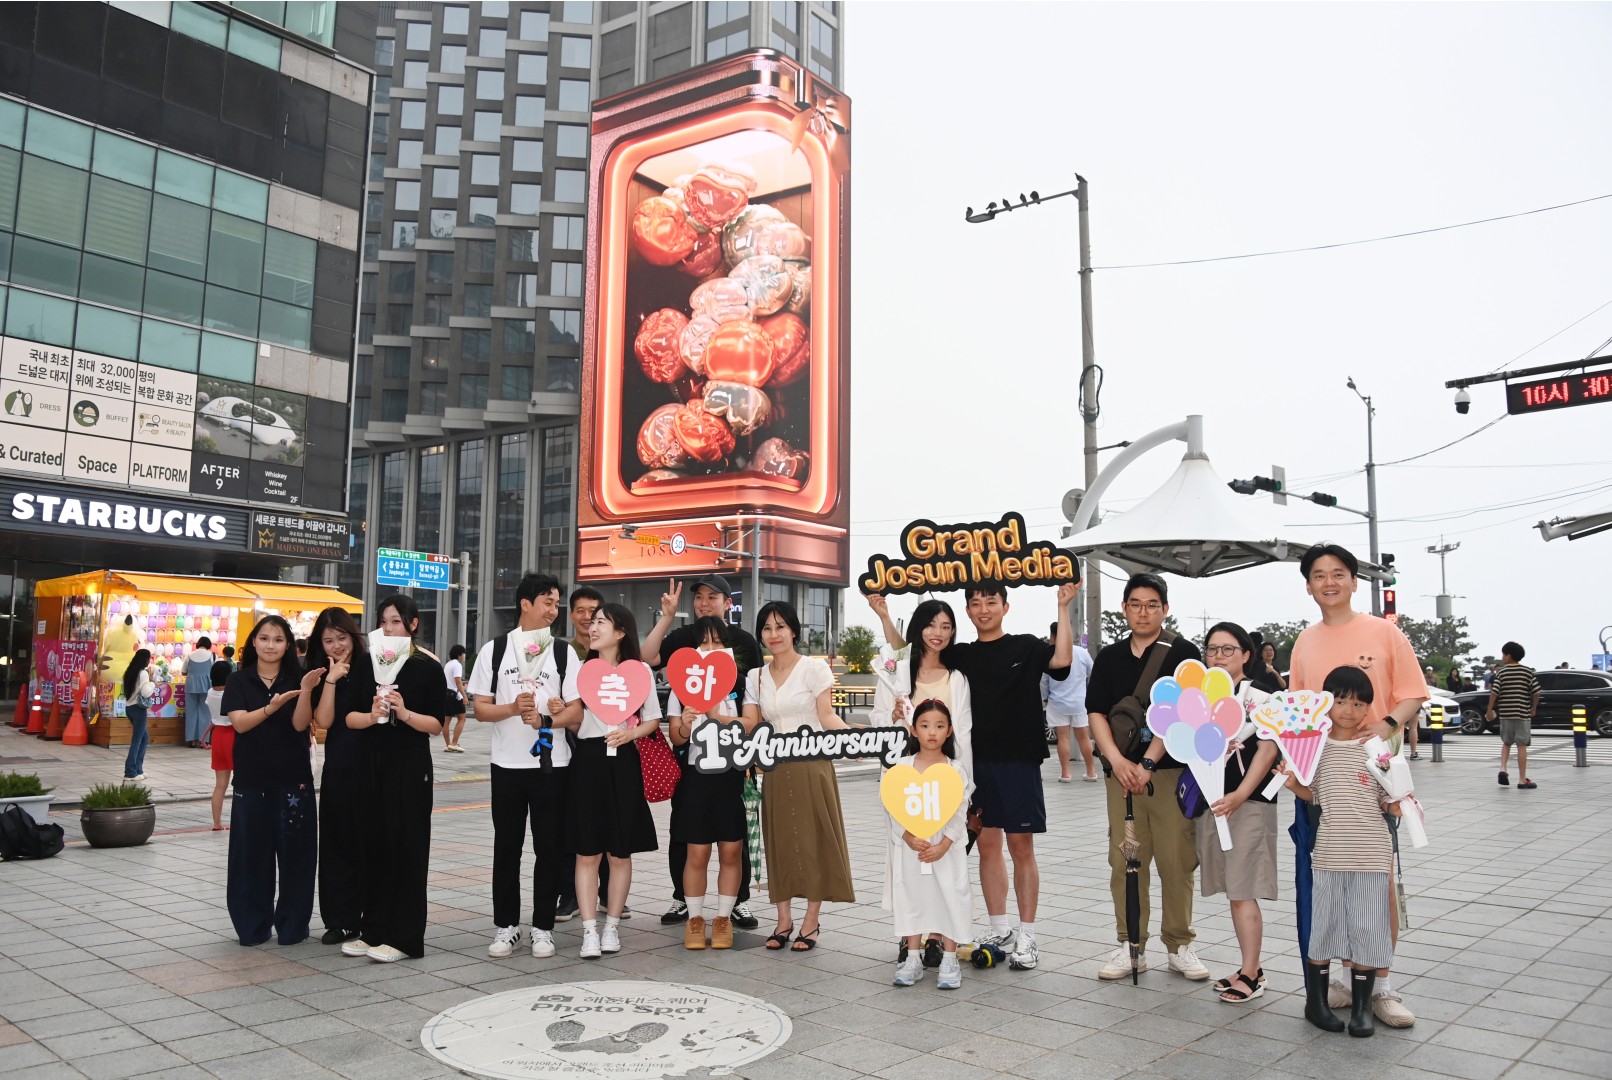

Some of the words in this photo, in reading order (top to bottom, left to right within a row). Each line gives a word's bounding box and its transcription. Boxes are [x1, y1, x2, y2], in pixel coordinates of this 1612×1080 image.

[29, 348, 48, 364] 국내
[50, 352, 70, 367] 최초
[76, 358, 96, 373] 최대
[100, 362, 136, 379] 32,000
[138, 370, 156, 384] 평의
[17, 363, 48, 380] 드넓은
[49, 369, 69, 384] 대지
[75, 373, 94, 389] 위에
[95, 377, 133, 395] 조성되는
[137, 385, 155, 400] 복합
[156, 389, 174, 404] 문화
[175, 392, 193, 407] 공간
[1522, 381, 1569, 406] 10시
[39, 402, 61, 412] DRESS
[105, 413, 129, 423] BUFFET
[161, 418, 179, 427] BEAUTY
[179, 421, 192, 429] SALON
[165, 427, 187, 437] K-BEAUTY
[9, 445, 63, 467] Curated
[77, 455, 118, 474] Space
[132, 462, 188, 484] PLATFORM
[200, 463, 240, 479] AFTER
[264, 470, 288, 481] Whiskey
[215, 478, 224, 490] 9
[263, 487, 287, 496] Cocktail
[268, 480, 283, 488] Wine
[290, 495, 298, 504] 2F
[11, 492, 227, 541] STARBUCKS
[255, 514, 277, 527] 새로운
[277, 516, 305, 530] 트렌드를
[305, 519, 326, 533] 이끌어
[907, 518, 1021, 560] Grand
[865, 558, 967, 592] Josun
[970, 547, 1074, 583] Media
[685, 664, 717, 701] 하
[597, 673, 630, 712] 축
[696, 722, 742, 770] 1st
[733, 724, 908, 766] Anniversary
[903, 780, 941, 821] 해
[530, 1002, 624, 1013] Photo
[632, 1004, 707, 1016] Spot
